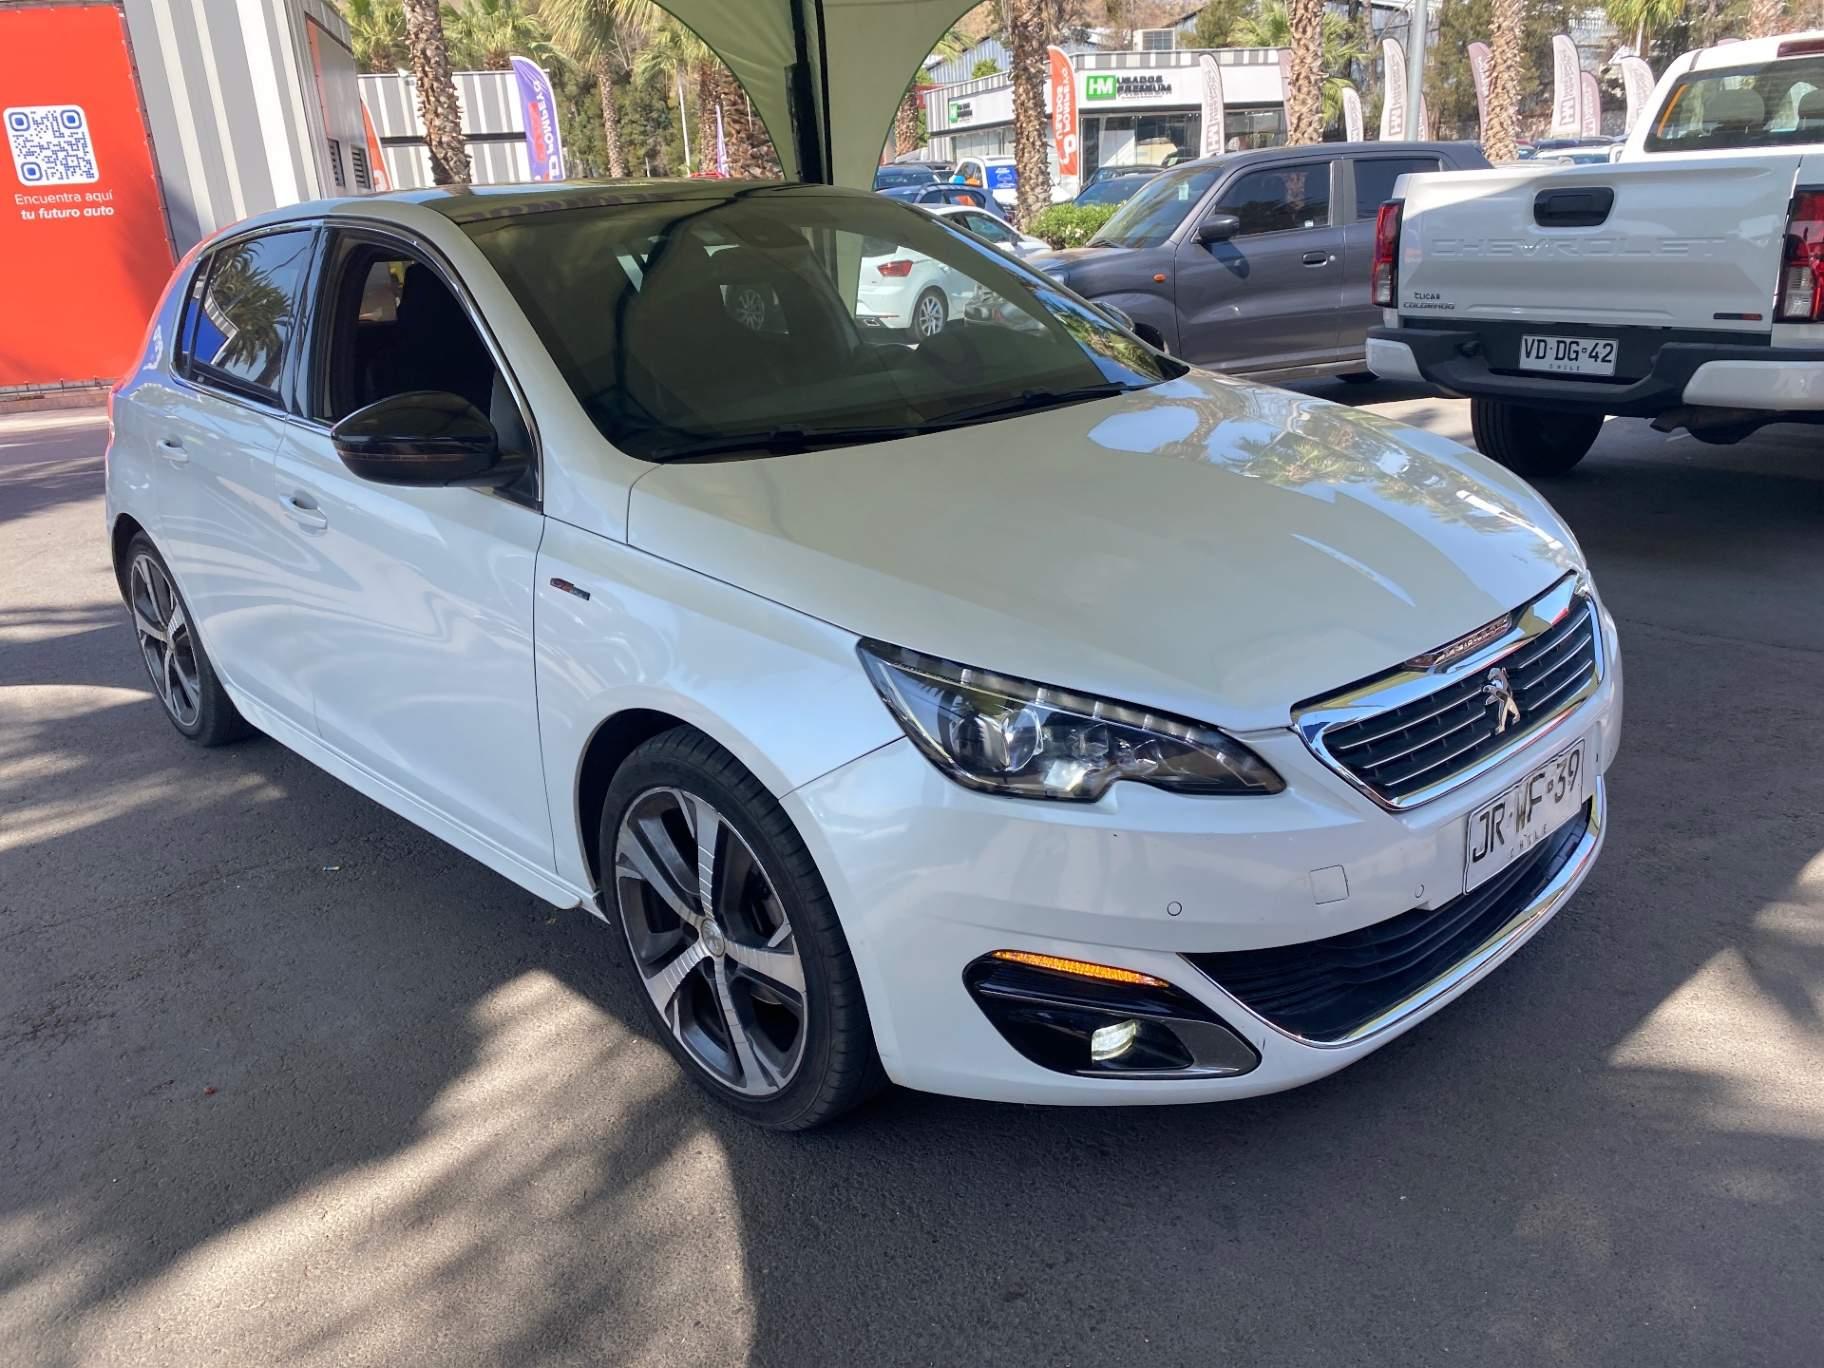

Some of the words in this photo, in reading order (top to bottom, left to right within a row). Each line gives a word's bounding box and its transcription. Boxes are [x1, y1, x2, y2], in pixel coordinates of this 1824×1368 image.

[1088, 77, 1114, 96] HM
[14, 193, 82, 205] Encuentra
[85, 189, 113, 204] aquí
[21, 209, 35, 220] tu
[39, 207, 80, 219] futuro
[84, 205, 115, 216] auto
[1431, 238, 1726, 256] CHEVROLET
